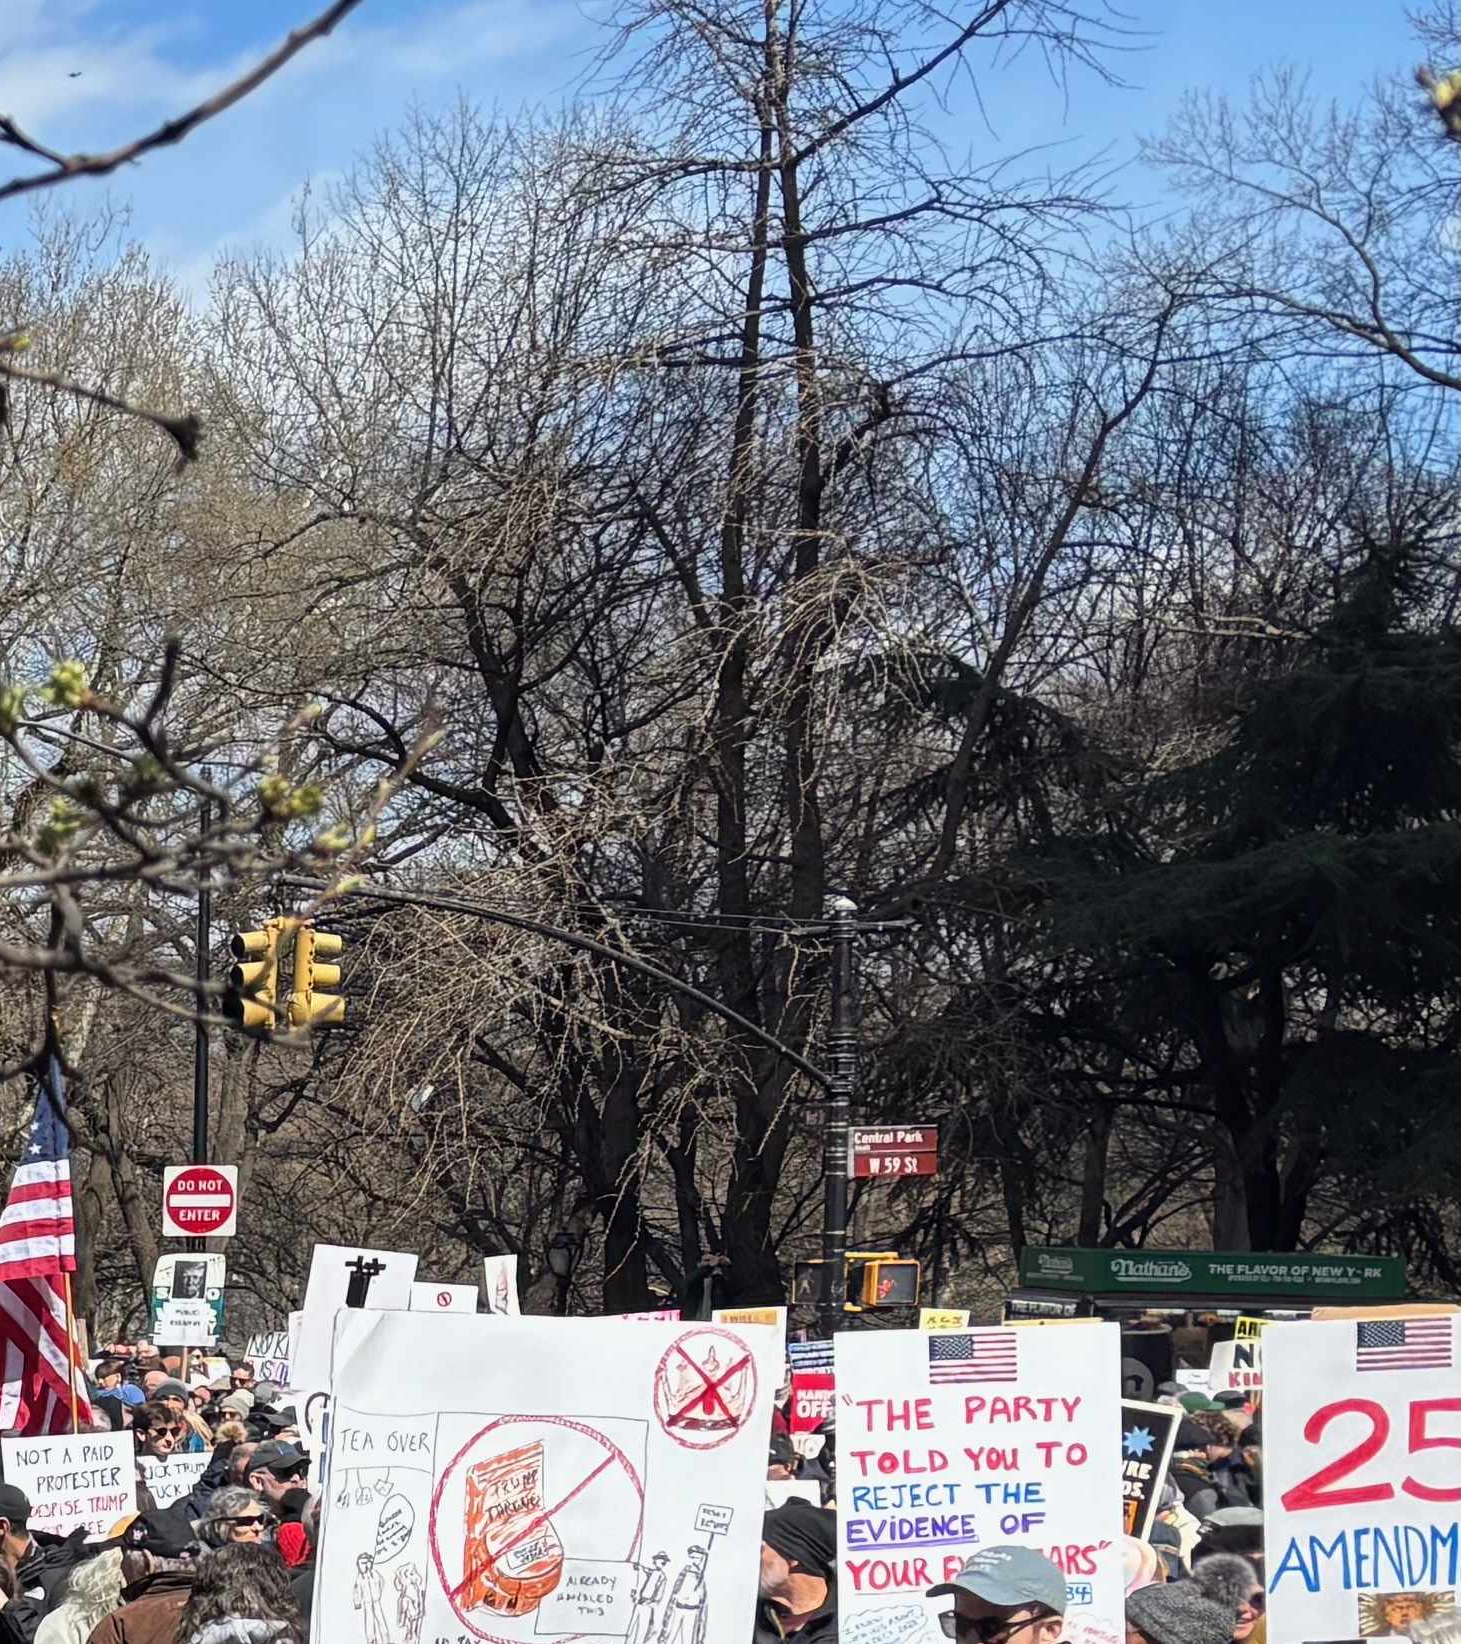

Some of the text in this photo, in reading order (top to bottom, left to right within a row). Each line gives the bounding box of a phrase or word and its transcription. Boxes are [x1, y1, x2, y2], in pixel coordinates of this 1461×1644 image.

[854, 1130, 924, 1144] Central Park
[869, 1156, 918, 1174] W 59 St
[178, 1179, 223, 1192] DO NOT
[179, 1209, 221, 1222] ENTER
[1110, 1258, 1192, 1281] Nathan's
[1208, 1264, 1382, 1279] THE FLAVOR OF NEW YRK
[796, 1401, 834, 1419] OFF
[965, 1396, 1082, 1424] PARTY
[341, 1428, 431, 1454] TEA OVER
[16, 1445, 114, 1467] NOT A PAID
[850, 1441, 1088, 1477] TOLD YOU TO
[36, 1466, 121, 1494] PROTESTER
[144, 1464, 171, 1481] UCK
[87, 1492, 128, 1514] TRUMP
[852, 1482, 1046, 1512] REJECT THE
[1000, 1512, 1046, 1535] OF
[1269, 1521, 1461, 1595] AMENDM
[566, 1575, 617, 1592] ALREADY
[845, 1558, 934, 1591] YOUR
